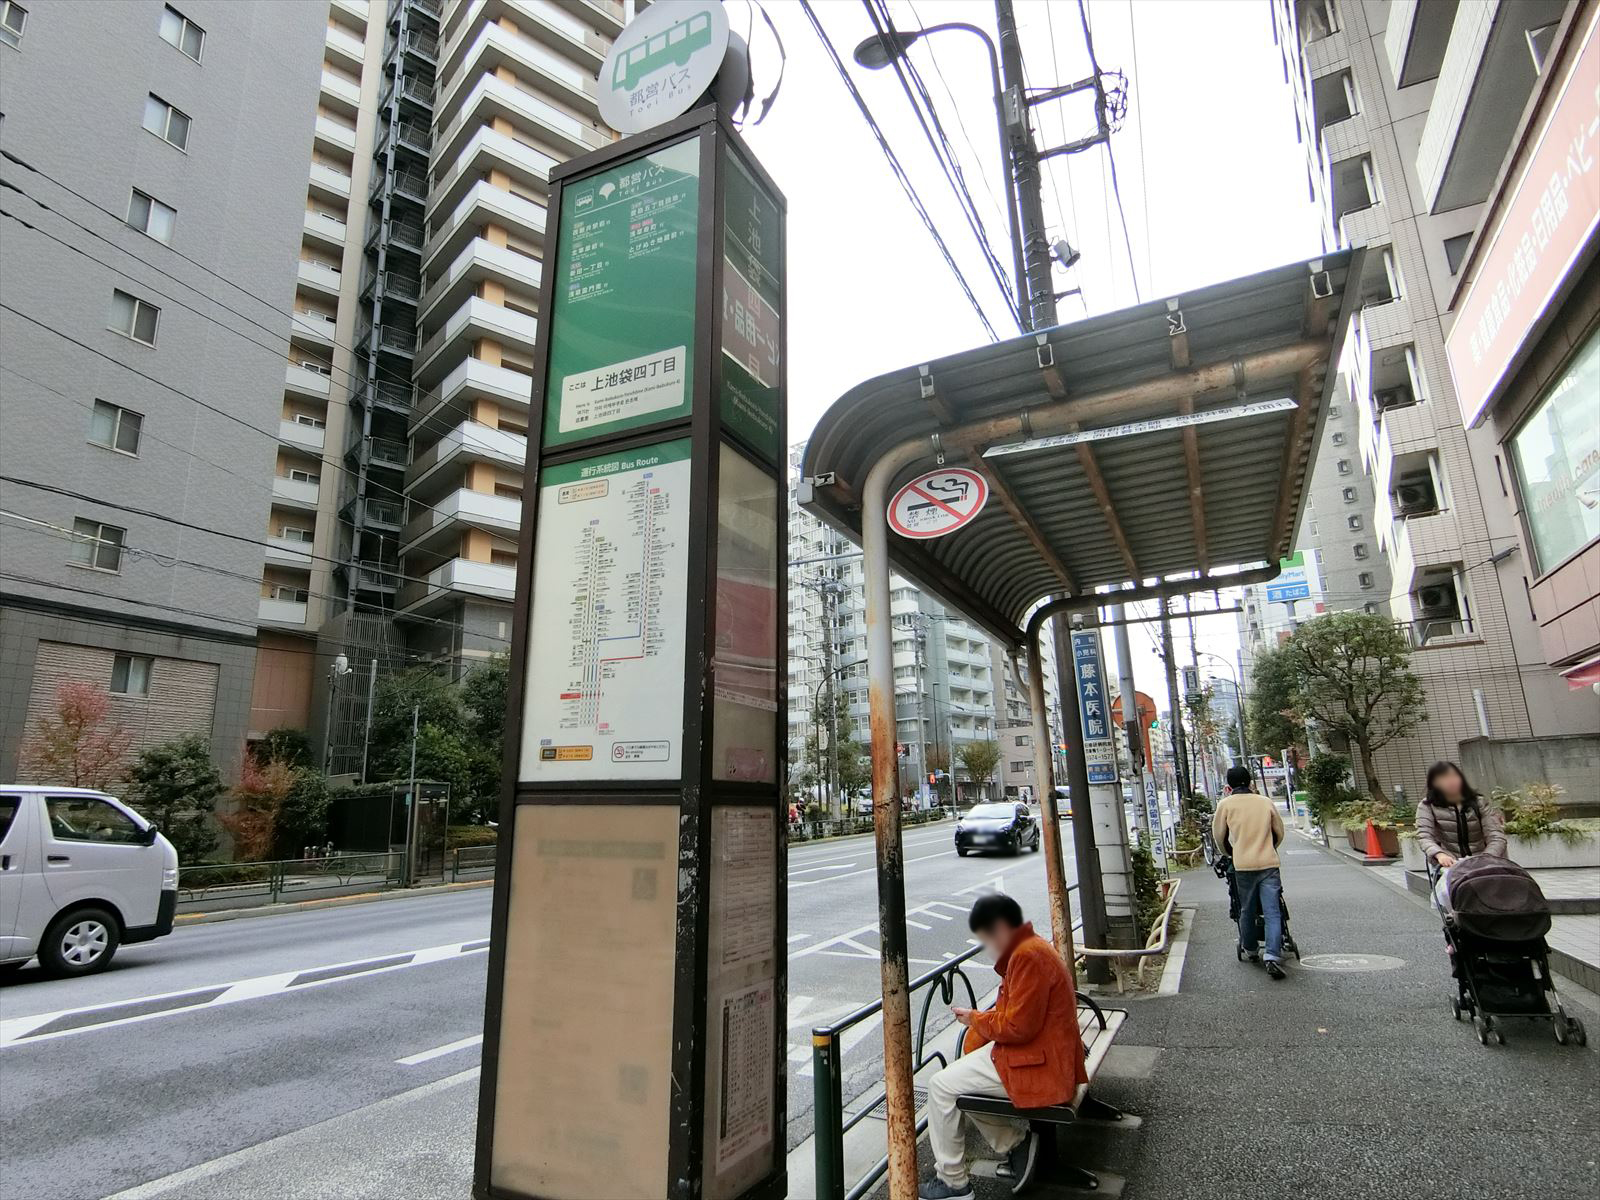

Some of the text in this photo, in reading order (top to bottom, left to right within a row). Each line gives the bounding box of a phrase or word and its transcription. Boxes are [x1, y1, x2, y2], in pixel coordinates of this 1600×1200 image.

[629, 69, 691, 106] 都営バス
[629, 85, 692, 117] Toei Bus
[619, 163, 665, 190] 都営バス
[747, 195, 761, 384] 上池袋四目
[569, 356, 676, 392] ここは 上池袋四丁目
[581, 457, 658, 478] 運行系統図 Bus Route
[1080, 663, 1103, 735] 藤本医院
[1146, 782, 1162, 854] バス停留所につき
